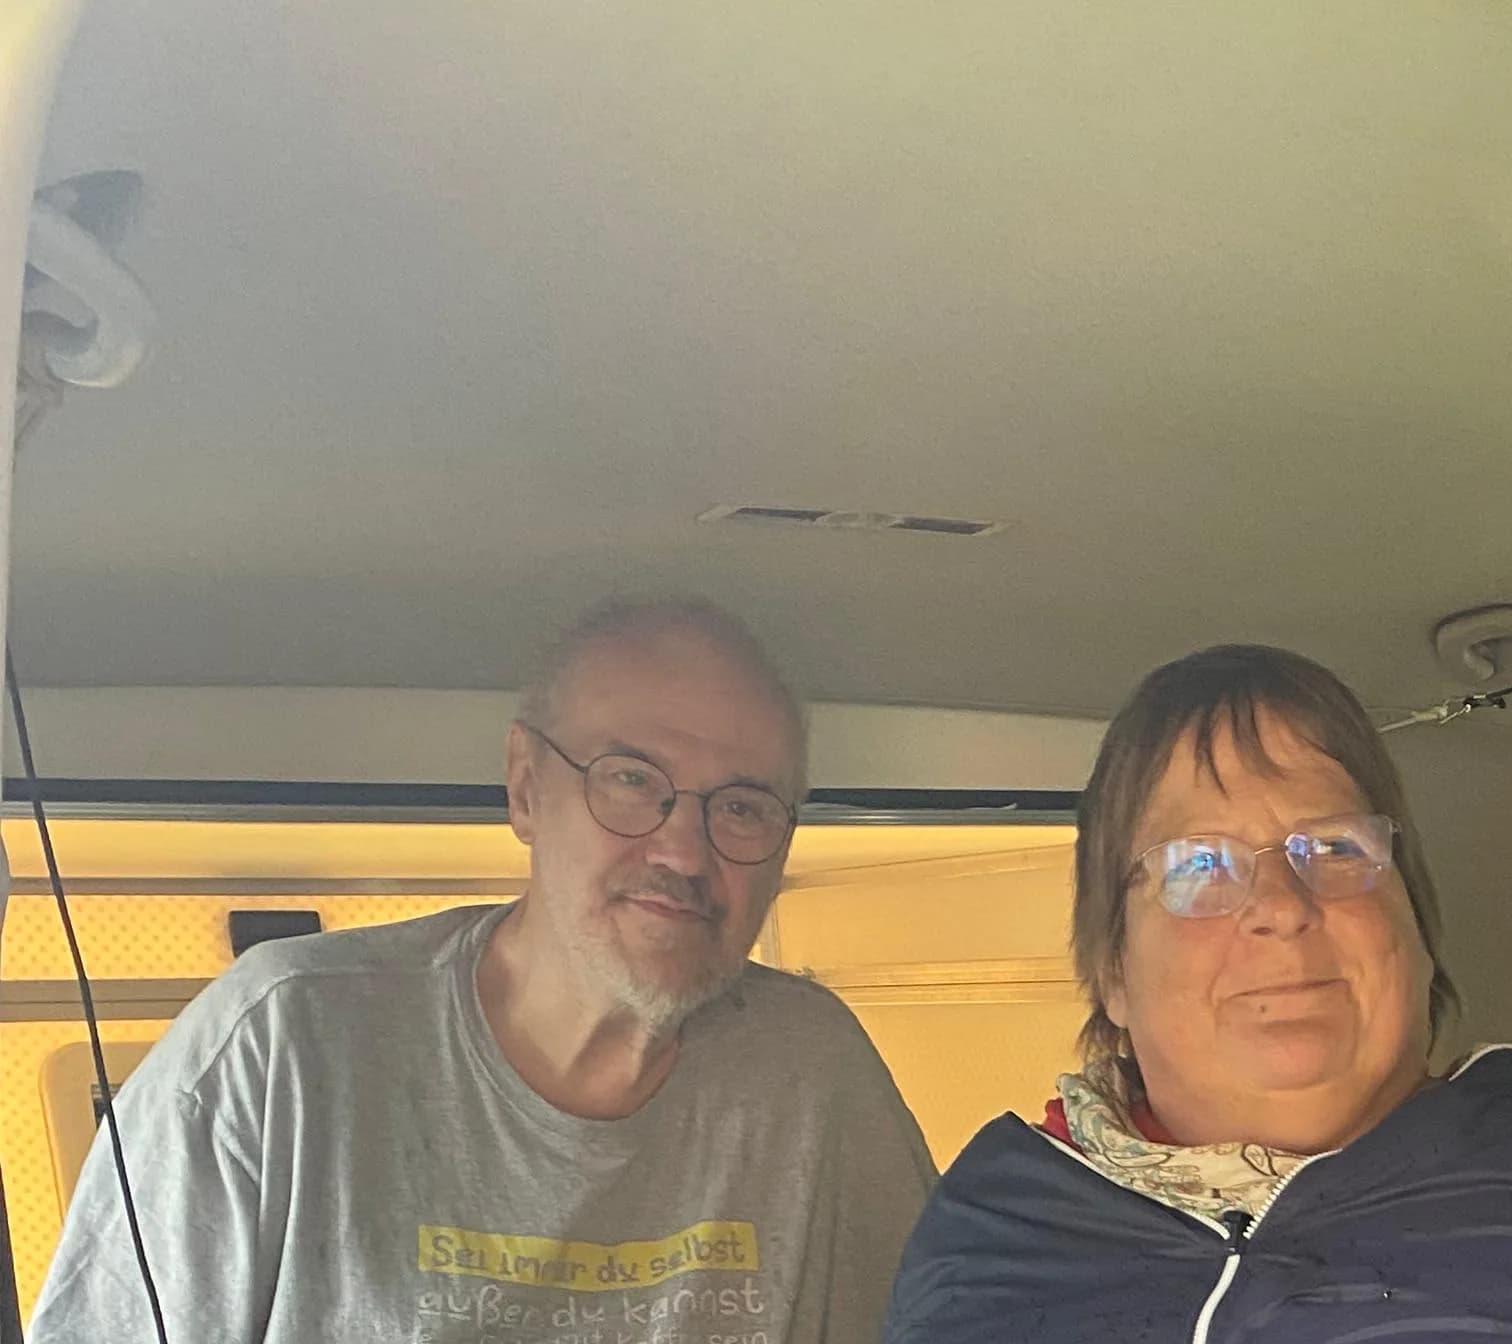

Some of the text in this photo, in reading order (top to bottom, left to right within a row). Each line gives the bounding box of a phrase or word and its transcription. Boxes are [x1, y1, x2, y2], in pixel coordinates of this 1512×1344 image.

[431, 1234, 488, 1270] Sei
[596, 1255, 640, 1283] du
[650, 1230, 745, 1278] selbst
[416, 1277, 765, 1329] außer du kannst
